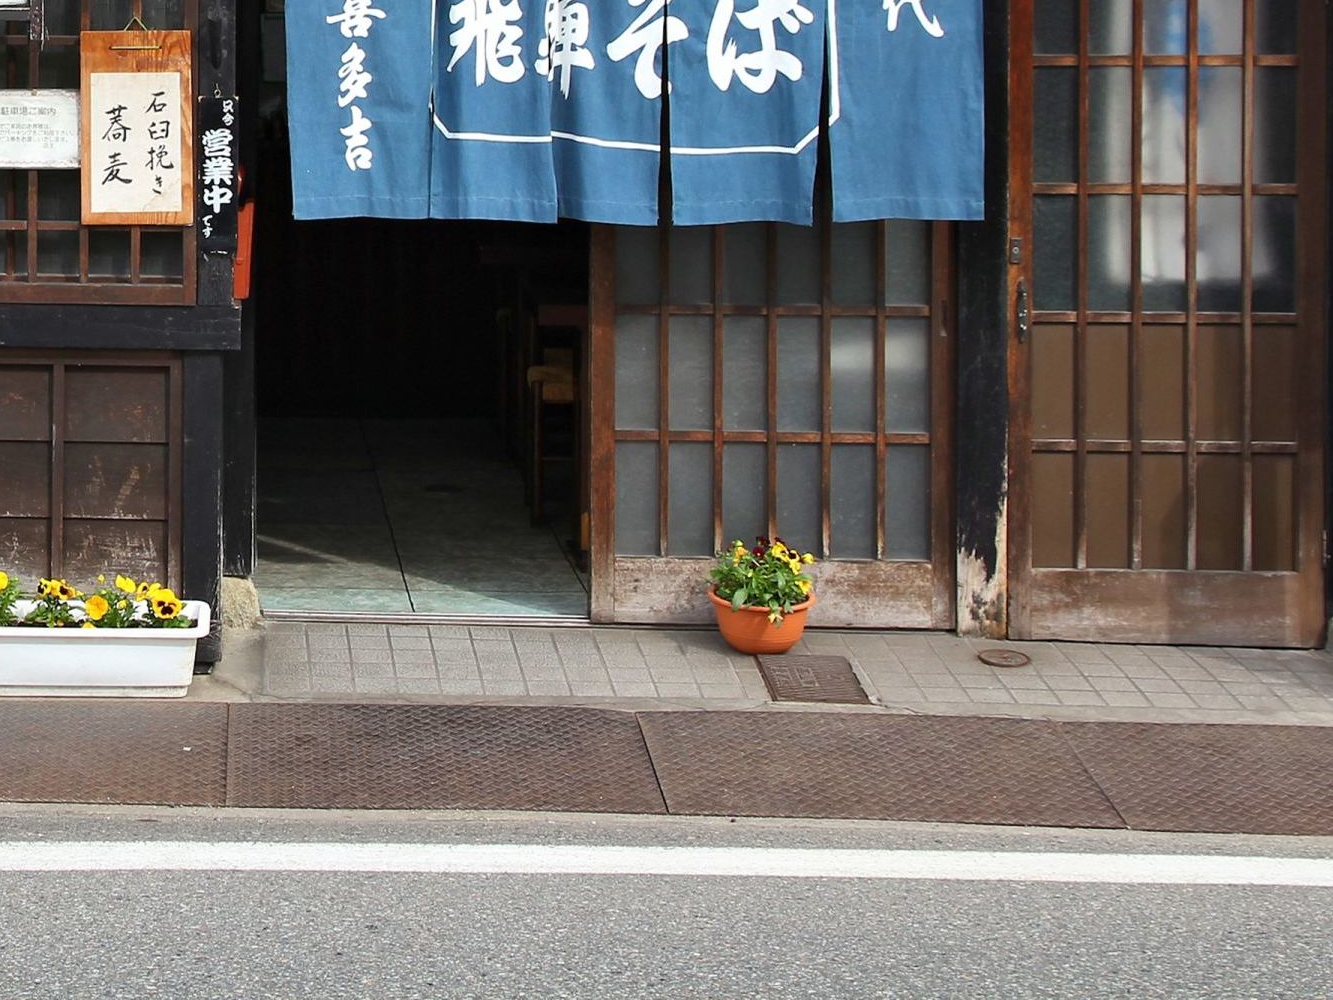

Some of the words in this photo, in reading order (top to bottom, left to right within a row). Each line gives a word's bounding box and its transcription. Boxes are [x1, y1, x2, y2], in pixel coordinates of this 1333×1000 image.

[102, 105, 132, 185] 蕎麦
[145, 91, 174, 195] 石臼挽き
